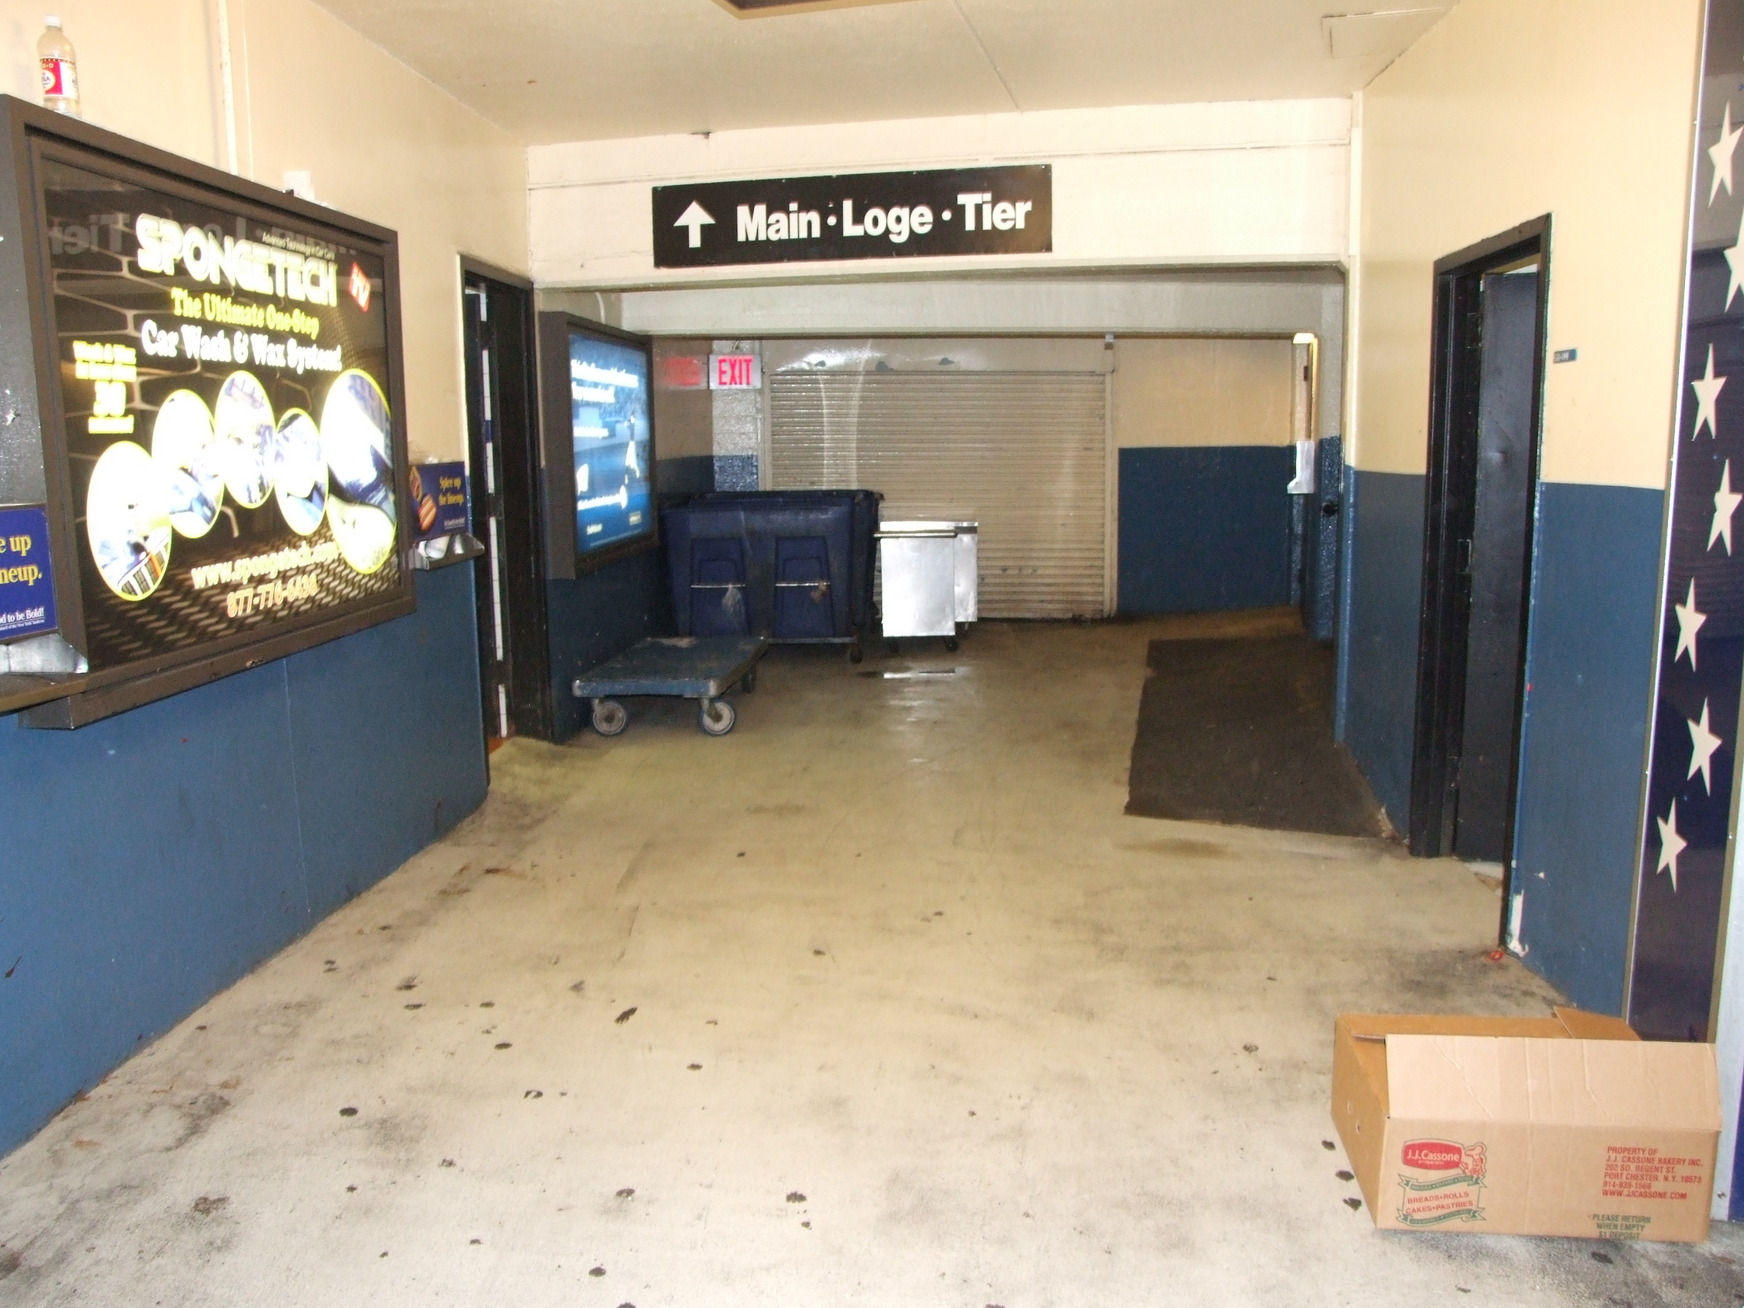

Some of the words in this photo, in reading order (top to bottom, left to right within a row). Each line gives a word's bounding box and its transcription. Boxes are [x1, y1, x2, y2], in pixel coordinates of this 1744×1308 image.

[736, 201, 821, 242] Main
[842, 199, 933, 244] Loge
[957, 191, 1032, 231] Tier
[136, 213, 338, 307] SPONGETECH
[171, 287, 202, 318] The
[204, 292, 265, 329] Ultimate
[266, 304, 320, 340] One-Step
[140, 319, 179, 358] Car
[181, 324, 232, 363] Wash
[233, 330, 249, 364] &
[250, 333, 286, 368] Wax
[718, 356, 753, 386] EXIT
[9, 535, 32, 557] up
[7, 613, 15, 623] to
[16, 610, 25, 621] be
[26, 606, 45, 619] Bold!
[1607, 1146, 1646, 1155] PROPERTY
[1648, 1147, 1658, 1155] OF
[1621, 1156, 1656, 1165] CASSONE
[1657, 1157, 1686, 1166] BAKERY
[1687, 1158, 1703, 1167] INC.
[1605, 1163, 1619, 1171] 202
[1635, 1165, 1664, 1173] REGENT
[1604, 1172, 1623, 1180] PORT
[1435, 1200, 1474, 1211] PASTRIES
[1592, 1214, 1619, 1222] PLEASE
[1621, 1215, 1651, 1224] RETURN
[1596, 1222, 1618, 1231] WHEN
[1620, 1223, 1646, 1232] EMPTY
[1609, 1232, 1641, 1240] DEPOSIT
